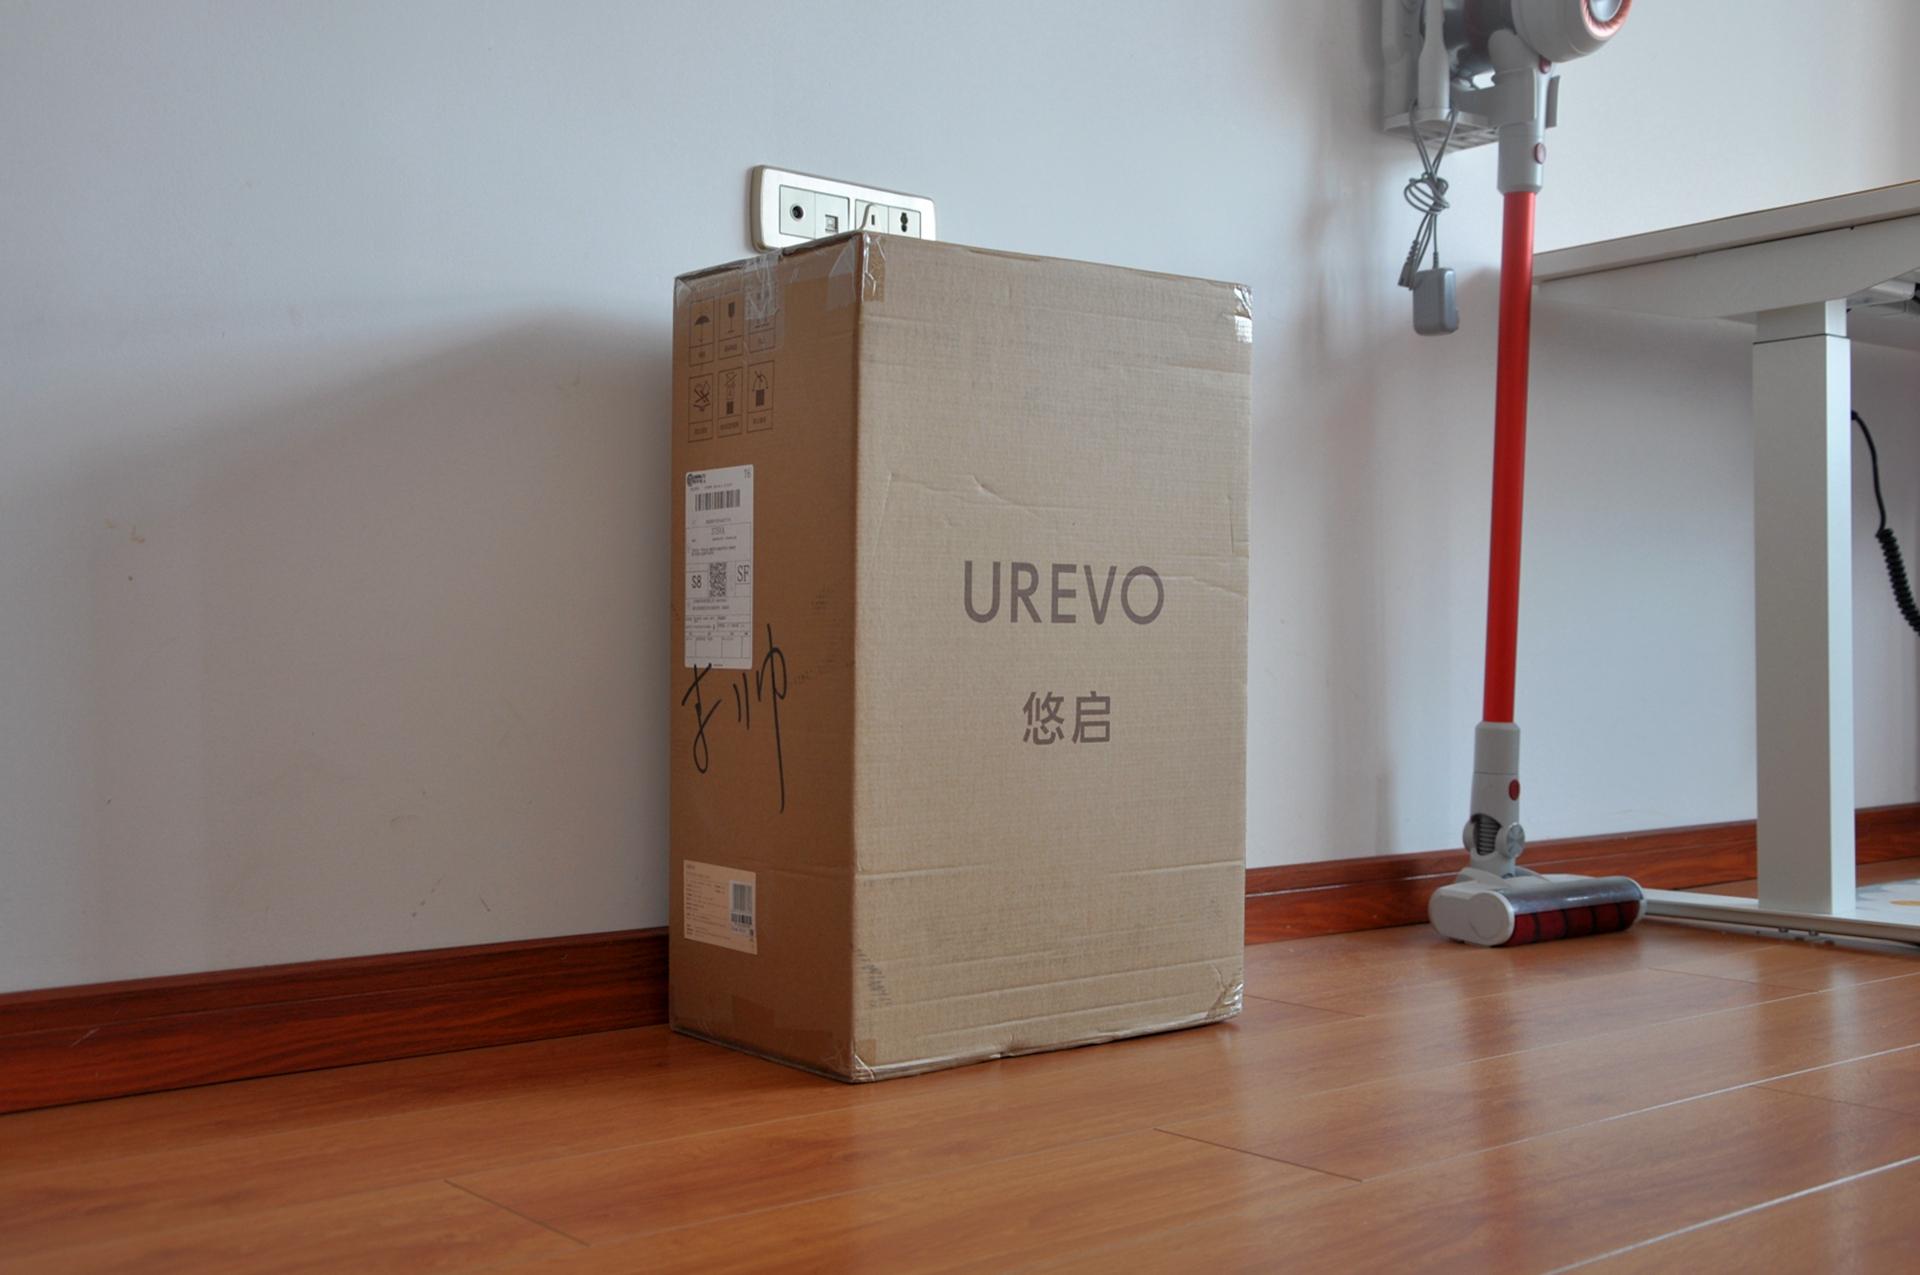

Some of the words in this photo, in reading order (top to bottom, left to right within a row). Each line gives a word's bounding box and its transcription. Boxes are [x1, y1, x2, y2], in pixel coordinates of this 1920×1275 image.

[691, 575, 702, 589] S8
[737, 564, 750, 583] SF
[963, 560, 1165, 626] UREVO
[1022, 690, 1111, 746] 悠启
